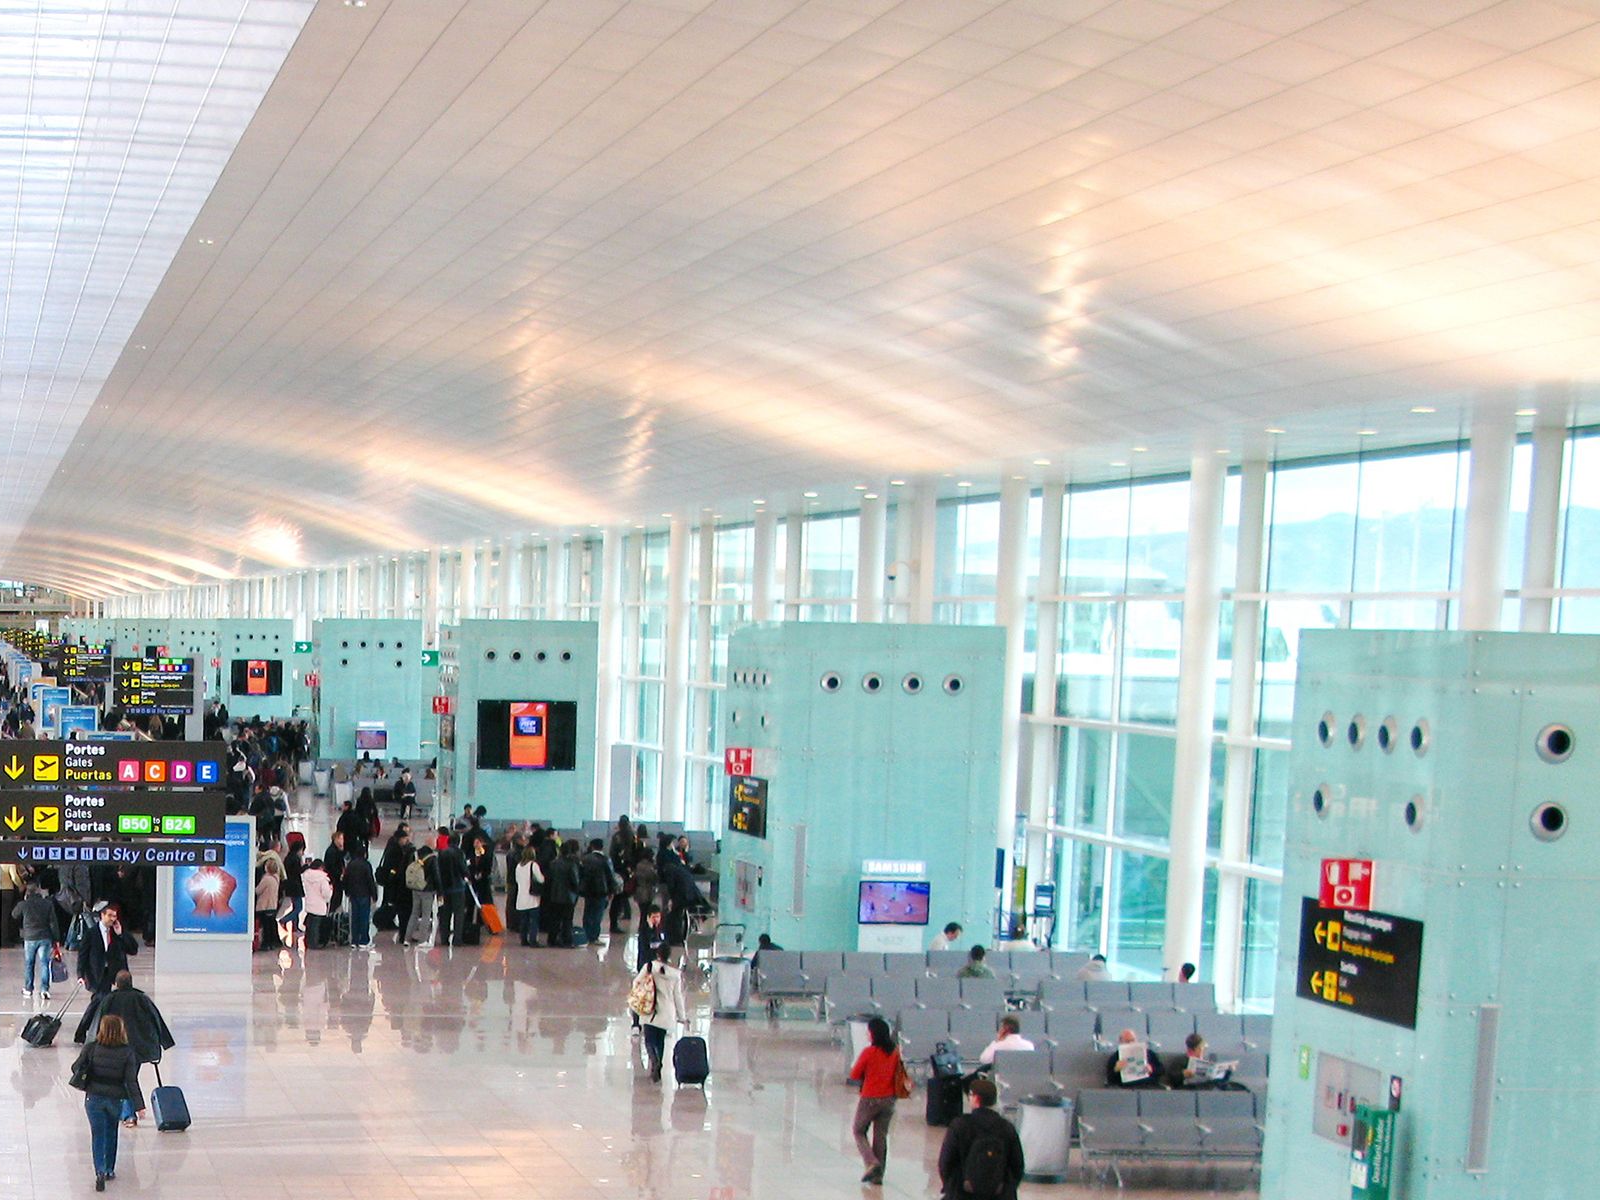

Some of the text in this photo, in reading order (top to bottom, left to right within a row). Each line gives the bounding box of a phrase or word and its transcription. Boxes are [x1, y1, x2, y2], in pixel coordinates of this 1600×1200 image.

[65, 743, 106, 756] Portes
[65, 757, 93, 768] Gates
[65, 766, 212, 780] Puertas A C D E
[64, 795, 105, 807] Portes
[64, 808, 93, 819] Gates
[64, 820, 112, 832] Puertas
[121, 818, 148, 830] B50
[164, 818, 192, 831] B24
[152, 817, 160, 825] to
[112, 848, 196, 863] Sky Centre
